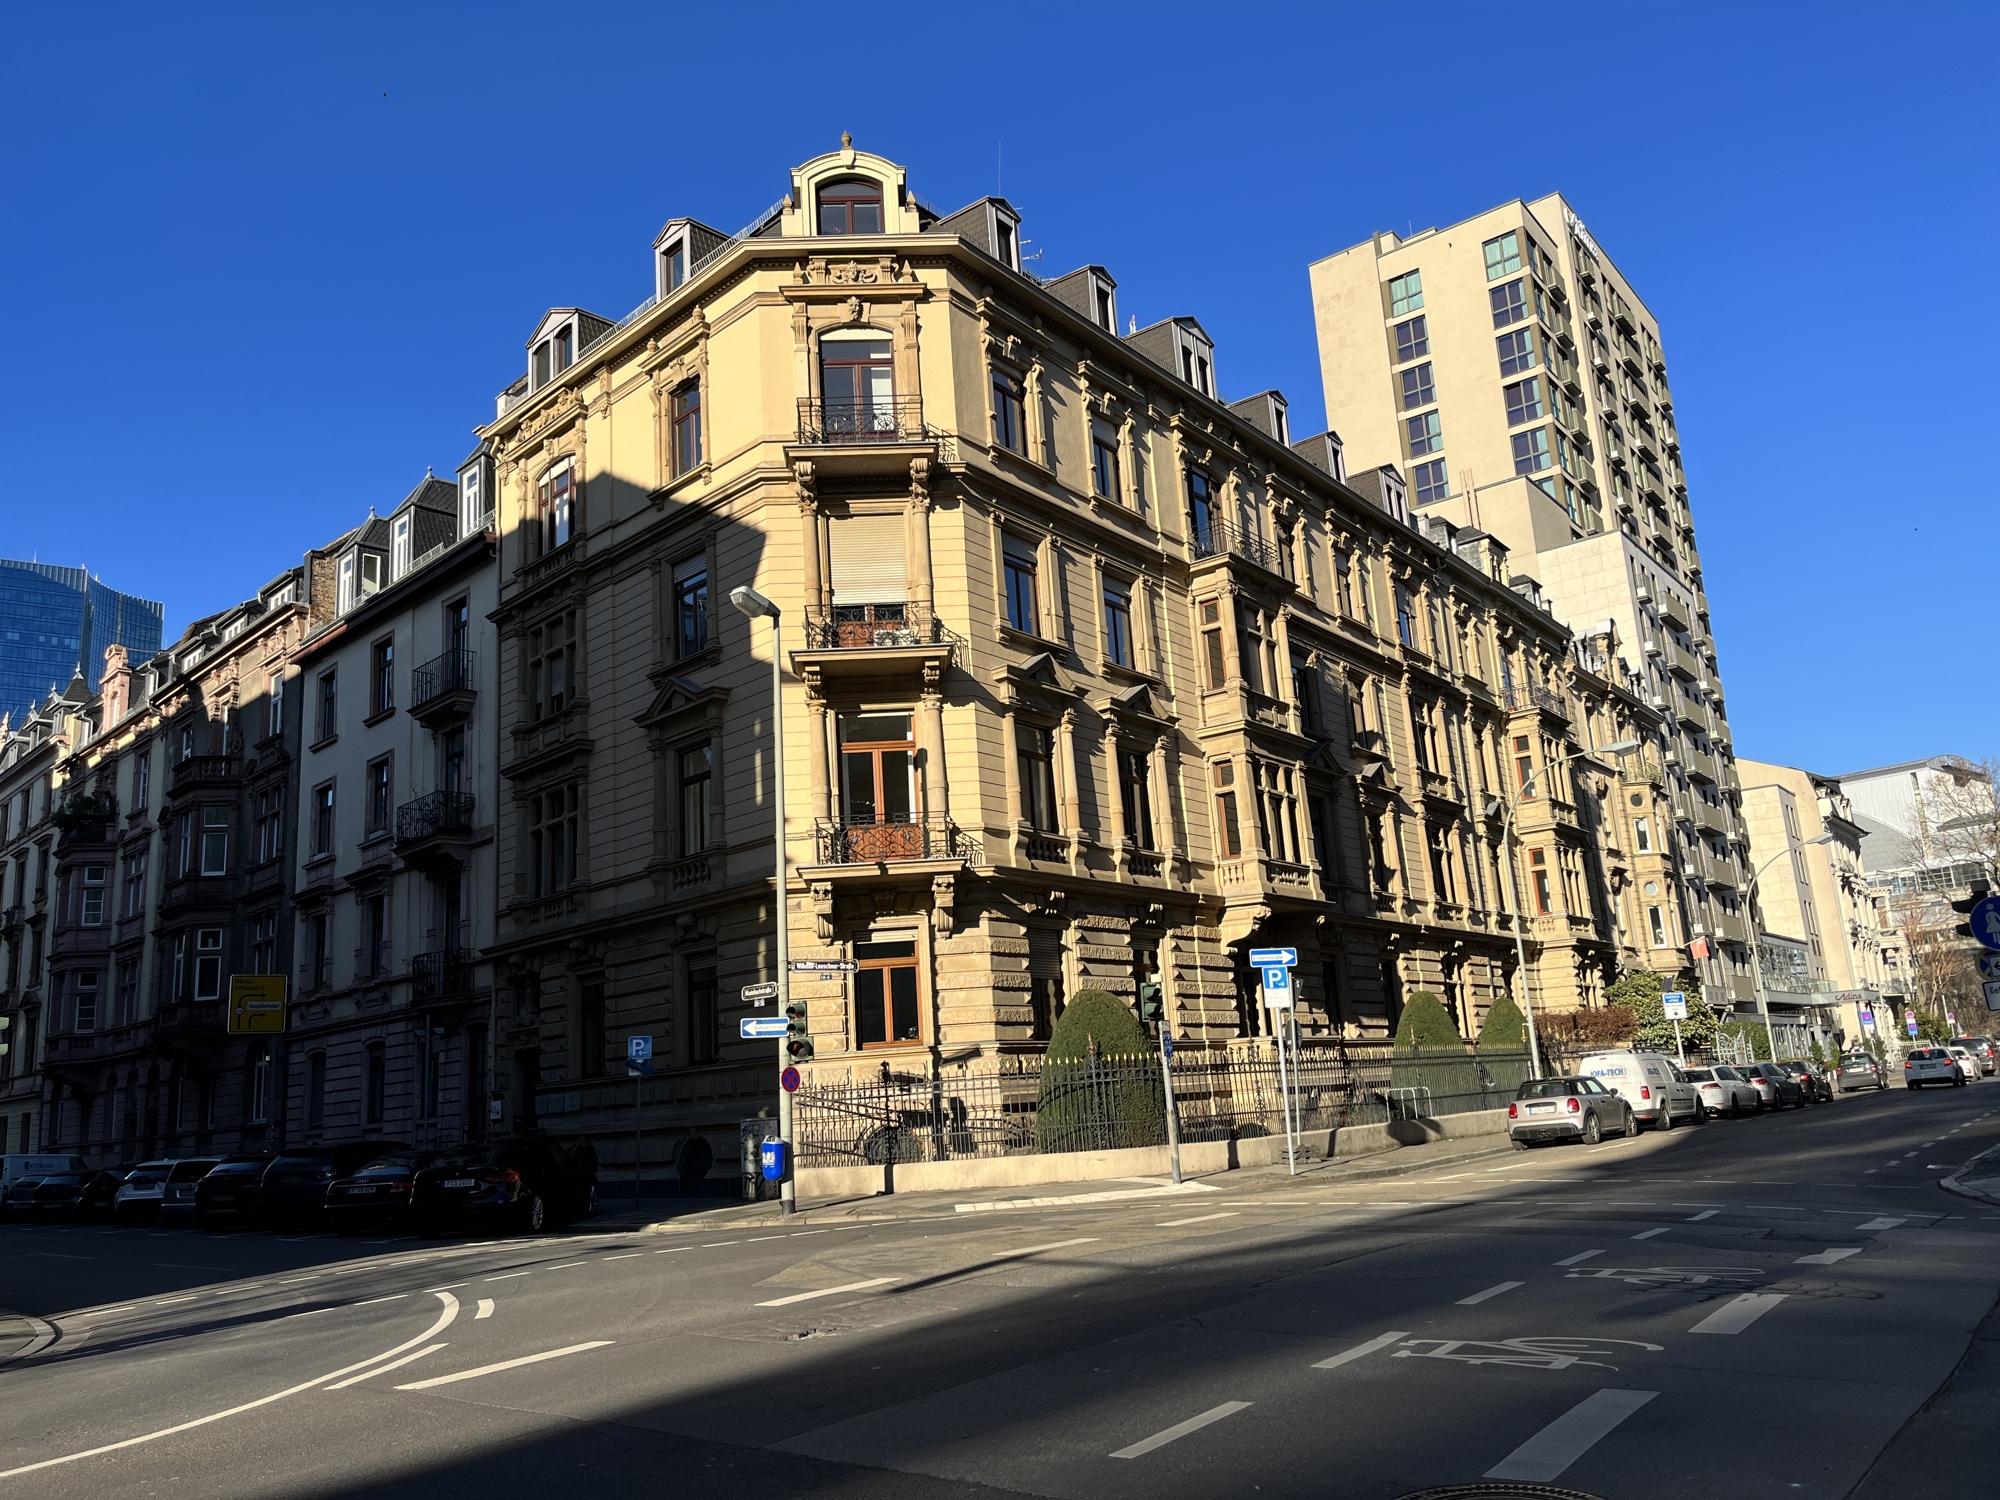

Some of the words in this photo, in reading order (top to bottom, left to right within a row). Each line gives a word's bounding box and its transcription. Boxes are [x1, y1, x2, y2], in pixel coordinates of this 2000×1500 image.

[1268, 970, 1282, 988] P
[1835, 992, 1862, 1000] Adina
[632, 1039, 645, 1056] P
